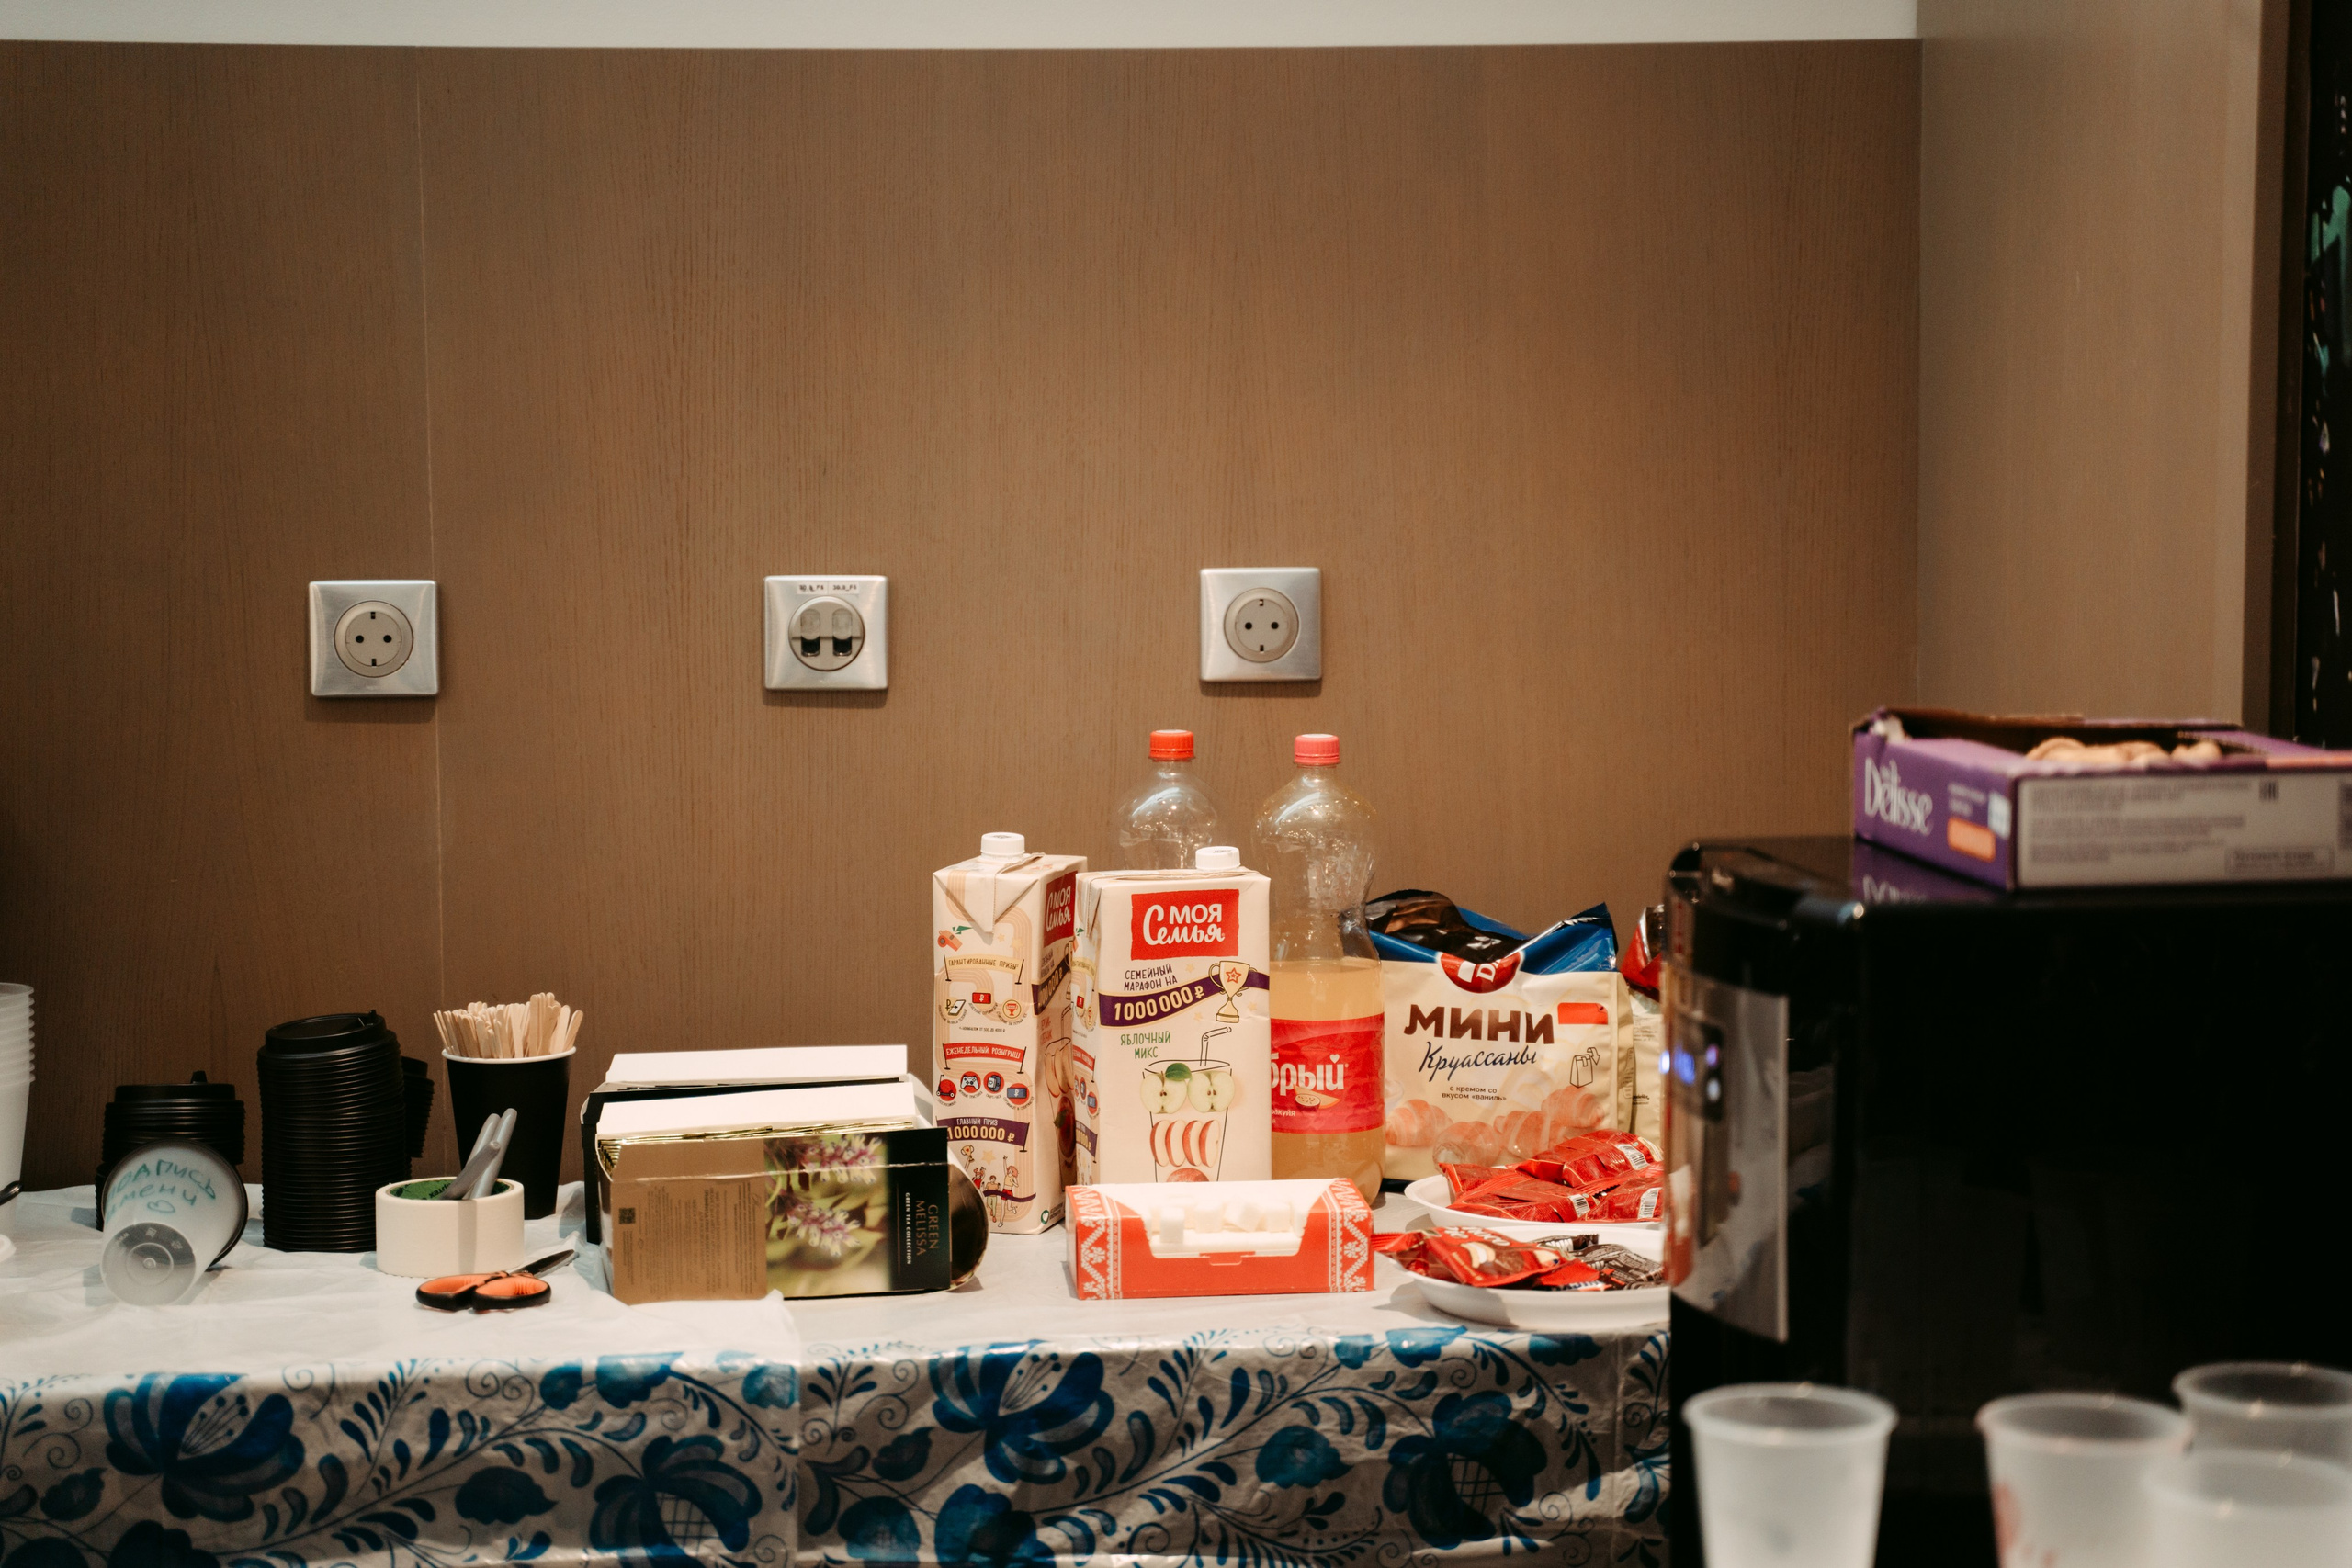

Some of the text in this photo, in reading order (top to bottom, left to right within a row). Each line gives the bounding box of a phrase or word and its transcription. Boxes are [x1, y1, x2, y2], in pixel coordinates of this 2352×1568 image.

[1169, 903, 1223, 925] МОЯ
[1142, 904, 1226, 946] Семья
[948, 958, 996, 966] ГАРАНТИРОВАННЫЕ
[1125, 964, 1173, 980] СЕМЕЙНЫЙ
[1124, 975, 1178, 991] МАРАФОН НА
[1404, 1004, 1555, 1045] МИНИ
[1120, 1031, 1171, 1046] ЯБЛОЧНЫЙ
[946, 1046, 1021, 1059] ЕЖЕНЕДЕЛЬНЫЙ РОЗЫГРЫШ
[1134, 1046, 1159, 1059] МИКС
[1419, 1041, 1537, 1082] Круассаны
[983, 1118, 999, 1126] ПРИЗ
[915, 1201, 927, 1257] MELISSA
[928, 1204, 940, 1249] GREEN
